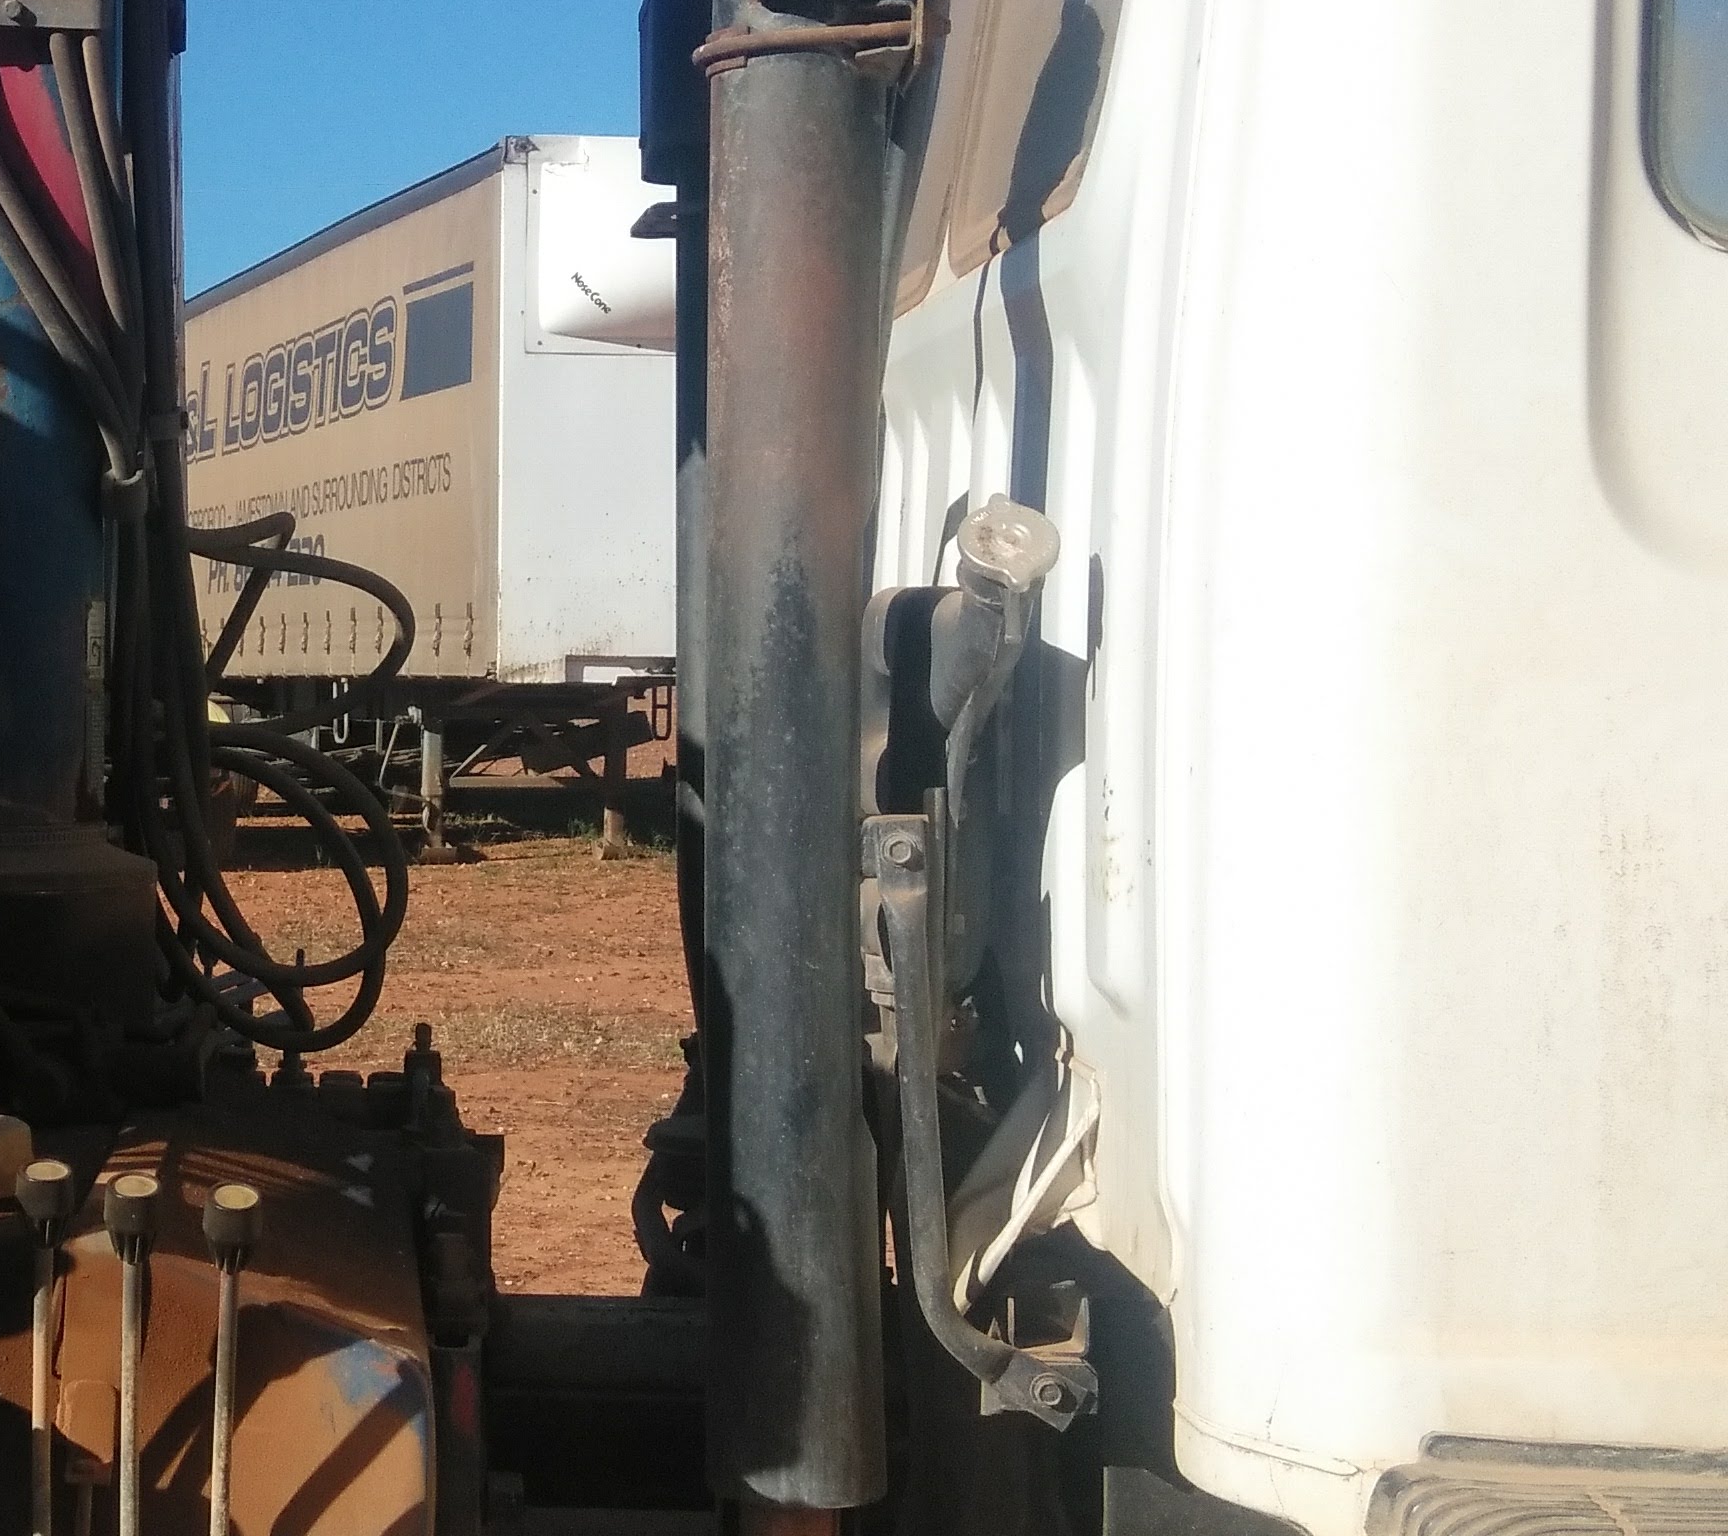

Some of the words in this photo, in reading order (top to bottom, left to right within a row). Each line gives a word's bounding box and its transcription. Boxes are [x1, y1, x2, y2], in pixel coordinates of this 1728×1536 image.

[571, 272, 592, 296] Nose
[590, 292, 612, 314] Cone
[222, 295, 398, 456] LOGISTICS
[290, 484, 309, 518] AND
[312, 466, 388, 515] SURROUNDING
[393, 452, 452, 500] DISTRICTS
